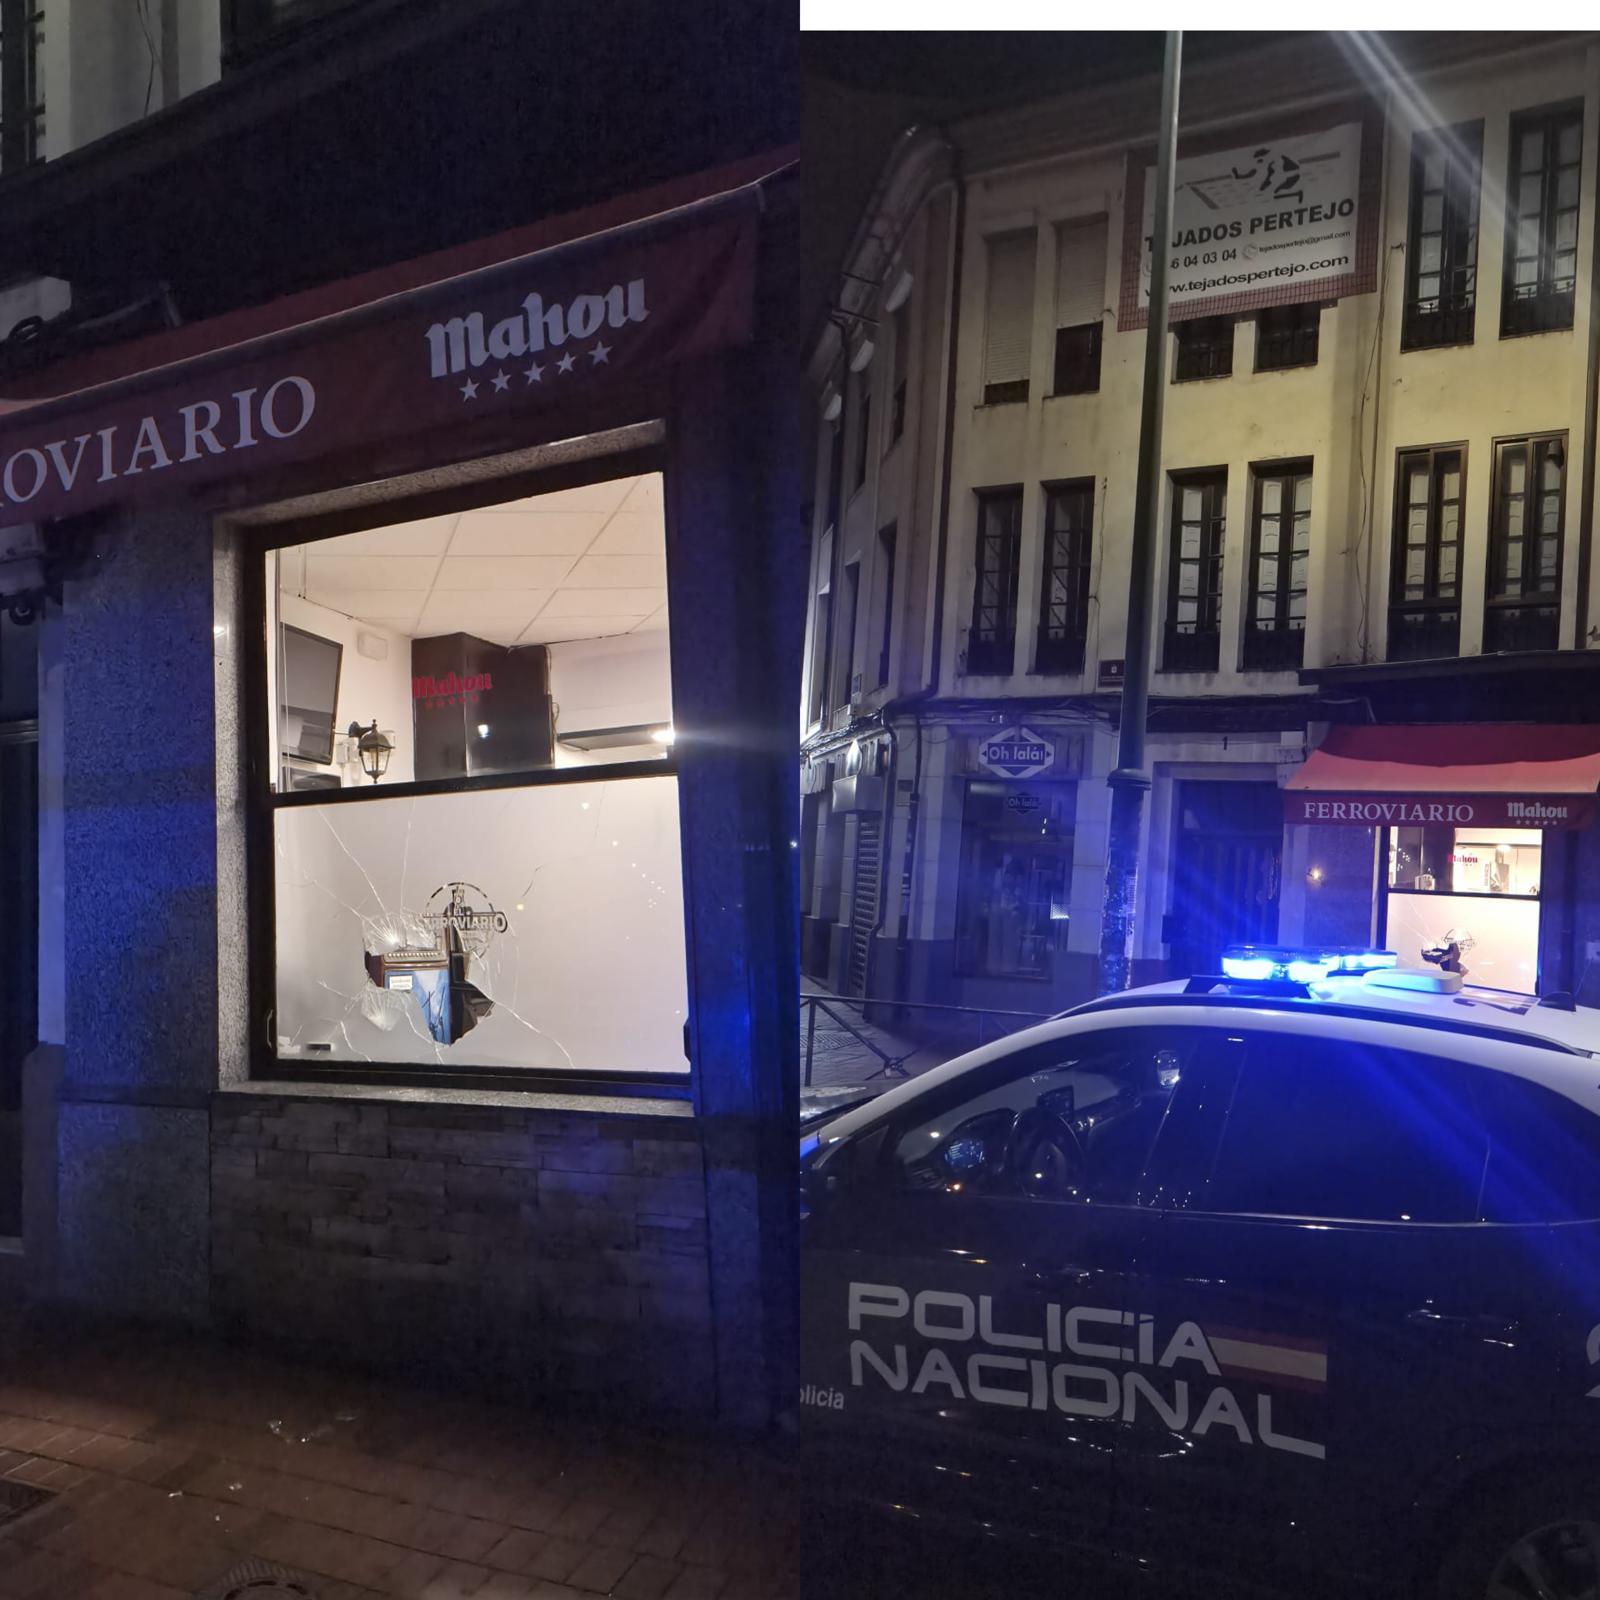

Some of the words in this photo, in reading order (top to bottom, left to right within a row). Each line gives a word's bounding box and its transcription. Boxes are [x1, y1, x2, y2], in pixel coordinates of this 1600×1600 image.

[1144, 221, 1242, 252] TJADOS
[1249, 198, 1354, 235] PERTEJO
[1145, 255, 1349, 297] w.tejadospertejo.com
[1183, 255, 1198, 268] 04
[1202, 251, 1217, 265] 03
[1222, 248, 1237, 261] 04
[424, 278, 650, 378] Mahou
[0, 375, 316, 508] OVIARIO
[989, 745, 1010, 761] Oh
[1304, 802, 1474, 823] FERROVIARIO
[1507, 801, 1568, 818] Mahou
[850, 1339, 1326, 1460] NACIONAL
